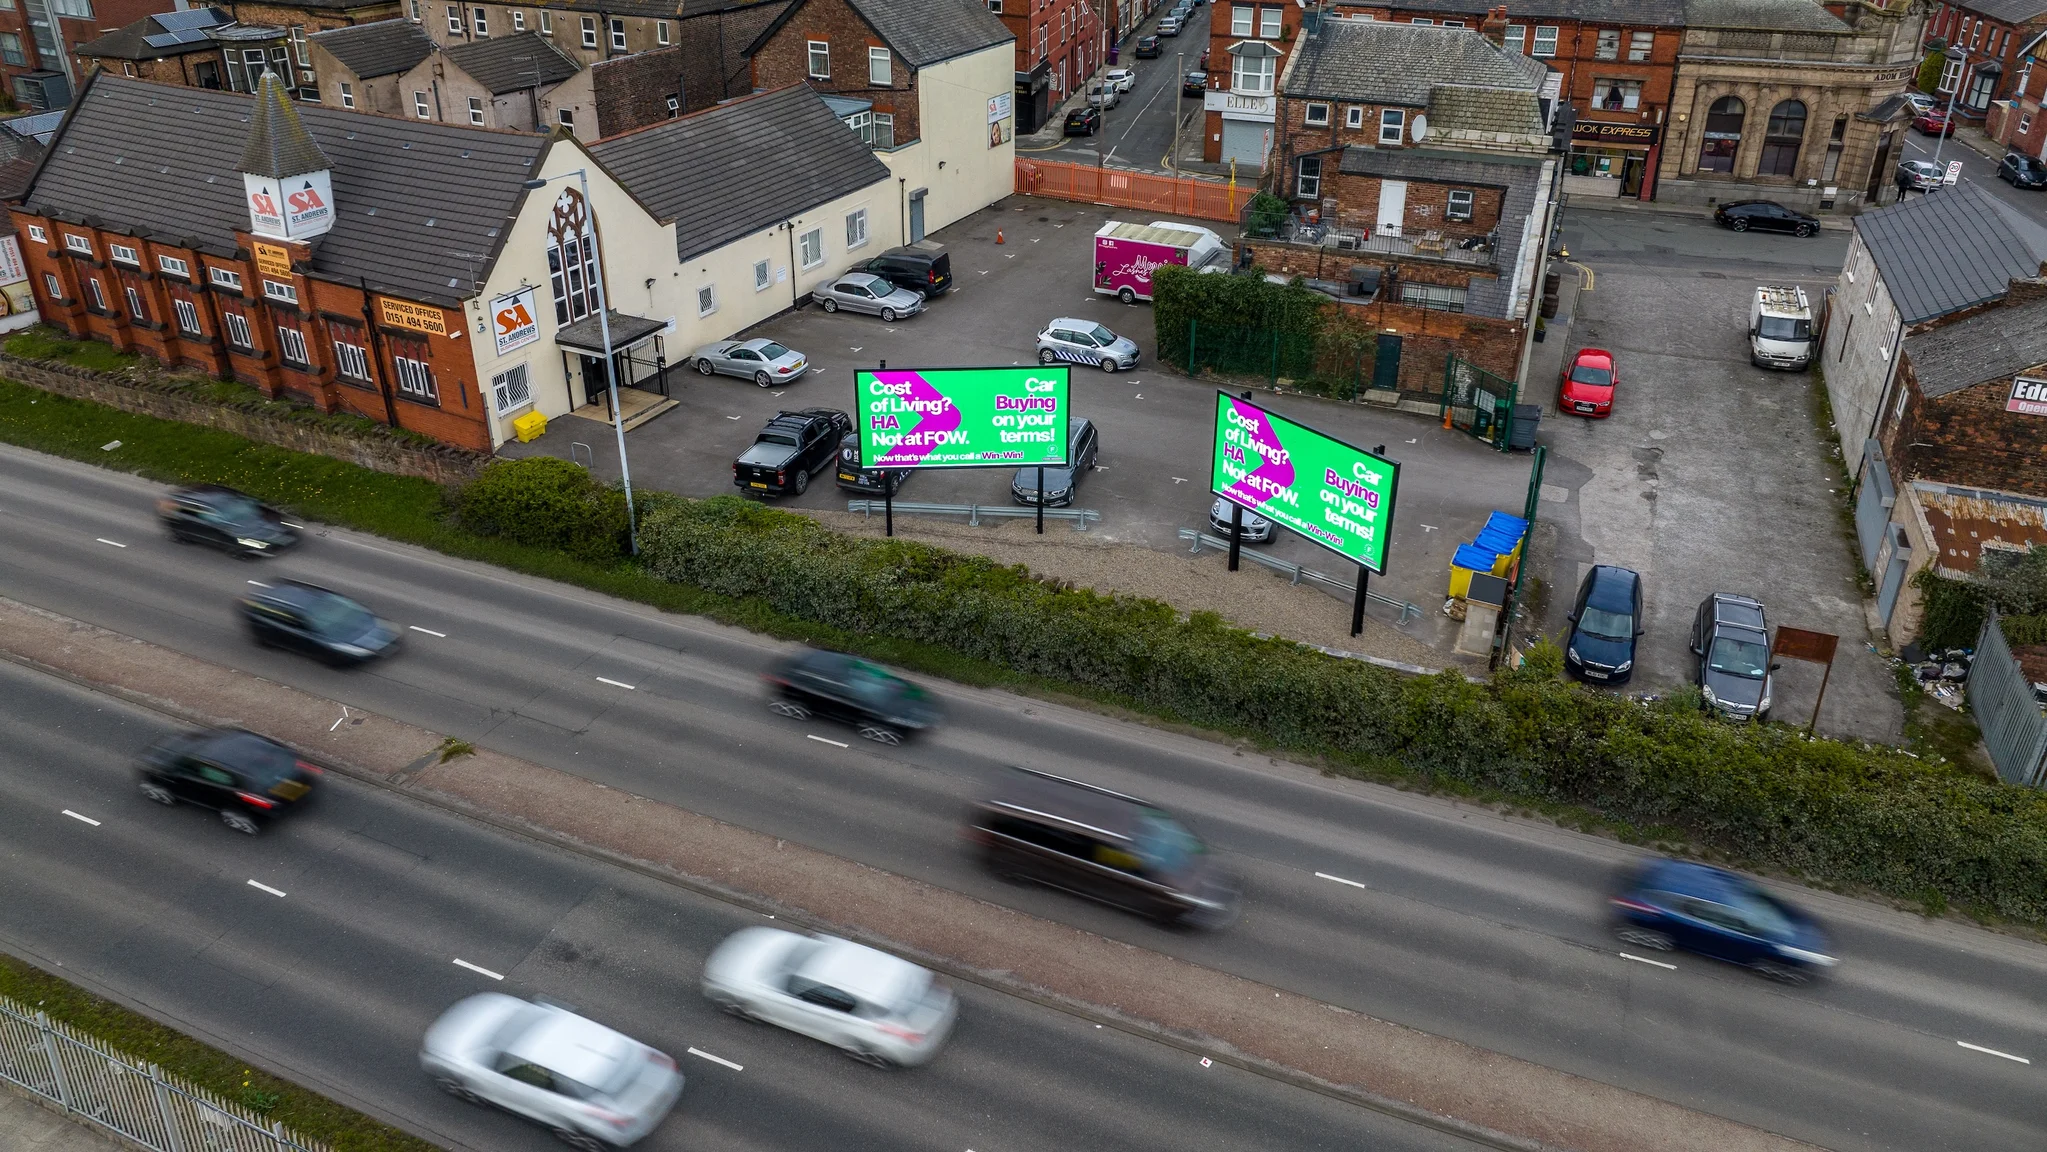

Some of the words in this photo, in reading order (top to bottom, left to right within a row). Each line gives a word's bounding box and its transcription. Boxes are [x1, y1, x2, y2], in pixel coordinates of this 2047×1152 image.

[1874, 73, 1897, 81] ADOM
[1227, 96, 1258, 110] ELLE
[1600, 126, 1653, 138] EXPRESS
[261, 216, 281, 227] ANDREWS
[292, 215, 300, 223] ST.
[301, 207, 328, 220] ANDREWS
[383, 300, 414, 315] SERVICED
[415, 307, 442, 321] OFFICES
[385, 311, 405, 325] 0151
[406, 316, 422, 329] 494
[423, 319, 444, 334] 5600
[499, 337, 508, 347] ST.
[508, 325, 536, 343] ANDREWS
[869, 380, 912, 396] Cost
[1024, 377, 1057, 393] Car
[870, 397, 888, 413] of
[890, 396, 952, 416] Living?
[995, 395, 1057, 413] Buying
[871, 414, 900, 430] HA
[992, 414, 1017, 427] on
[1018, 413, 1057, 430] your
[1226, 407, 1260, 434] Cost
[871, 431, 903, 447] Not
[904, 432, 923, 446] at
[924, 430, 970, 446] FOW.
[1000, 428, 1056, 443] terms!
[1223, 442, 1245, 464] HA
[1225, 427, 1241, 442] of
[1240, 431, 1289, 466] Living?
[873, 453, 893, 463] Now
[893, 452, 919, 463] that's
[918, 452, 942, 462] what
[942, 453, 959, 463] you
[959, 452, 976, 461] call
[981, 450, 1024, 460] Win-Win!
[1352, 461, 1383, 486] Car
[1222, 460, 1247, 483] Not
[1247, 474, 1262, 489] at
[1262, 477, 1300, 508] FOW.
[1325, 468, 1380, 508] Buying
[1221, 481, 1238, 497] Now
[1236, 487, 1258, 505] that's
[1256, 498, 1276, 515] what
[1274, 507, 1290, 521] you
[1288, 513, 1302, 528] call
[1307, 522, 1344, 547] Win-Win!
[1319, 489, 1341, 508] on
[1340, 495, 1378, 523] your
[1324, 507, 1375, 542] terms!
